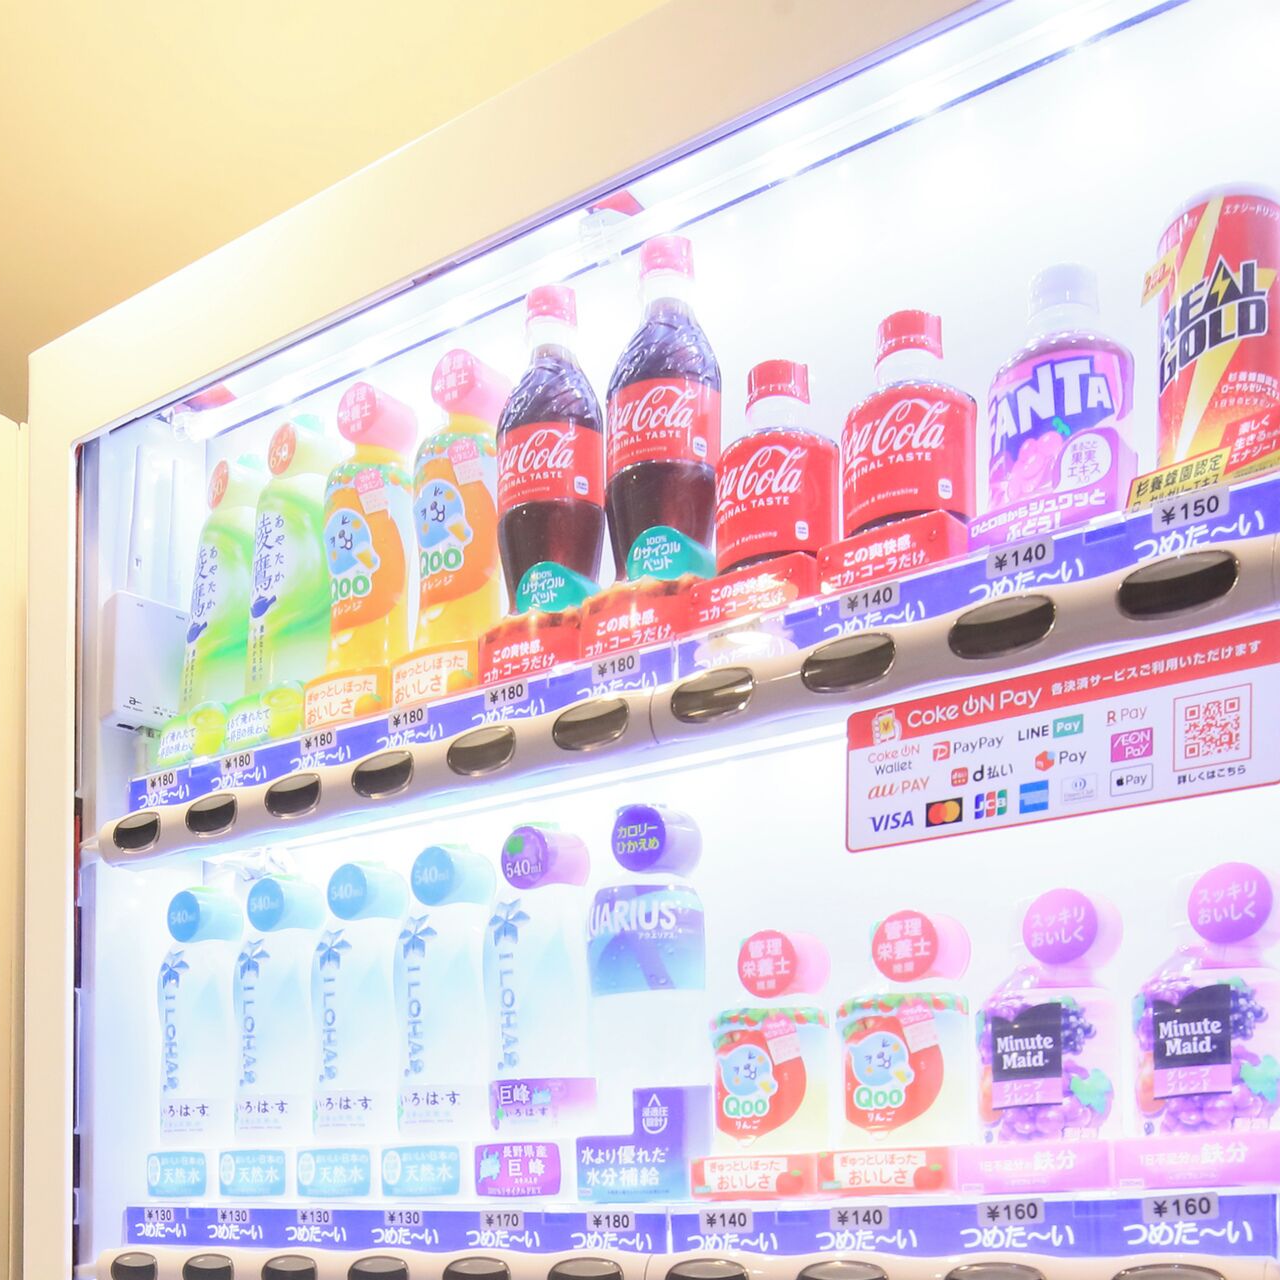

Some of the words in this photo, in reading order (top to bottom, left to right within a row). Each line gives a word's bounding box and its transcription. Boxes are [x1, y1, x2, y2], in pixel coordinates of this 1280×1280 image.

[1160, 495, 1220, 526] ¥150
[993, 543, 1047, 571] ¥140
[847, 586, 893, 612] ¥140
[598, 655, 635, 677] ¥180
[1051, 640, 1262, 696] 各決済サービスご利用いただけます
[489, 684, 523, 704] ¥180
[907, 704, 959, 728] Coke
[999, 686, 1043, 713] Pay
[392, 708, 424, 728] ¥180
[1018, 724, 1049, 742] LINE
[1055, 718, 1081, 738] Pay
[304, 733, 333, 750] ¥180
[953, 734, 1004, 755] PayPay
[874, 759, 913, 776] Wallet
[1177, 764, 1247, 785] 詳しくはこちら
[149, 772, 174, 787] ¥180
[901, 776, 930, 794] PAY
[868, 810, 915, 833] VISA
[1159, 1018, 1222, 1039] Minute
[996, 1034, 1054, 1054] Minute
[1165, 1036, 1212, 1056] Maid
[1002, 1051, 1045, 1069] Maid
[724, 1095, 768, 1117] Qoo
[855, 1087, 904, 1109] Qoo
[848, 1167, 909, 1186] おいしさ
[147, 1208, 172, 1222] ¥130
[986, 1202, 1039, 1222] ¥160
[1152, 1196, 1212, 1218] ¥160
[387, 1210, 421, 1225] ¥130
[485, 1213, 520, 1228] ¥170
[593, 1213, 631, 1229] ¥180
[705, 1212, 748, 1228] ¥140
